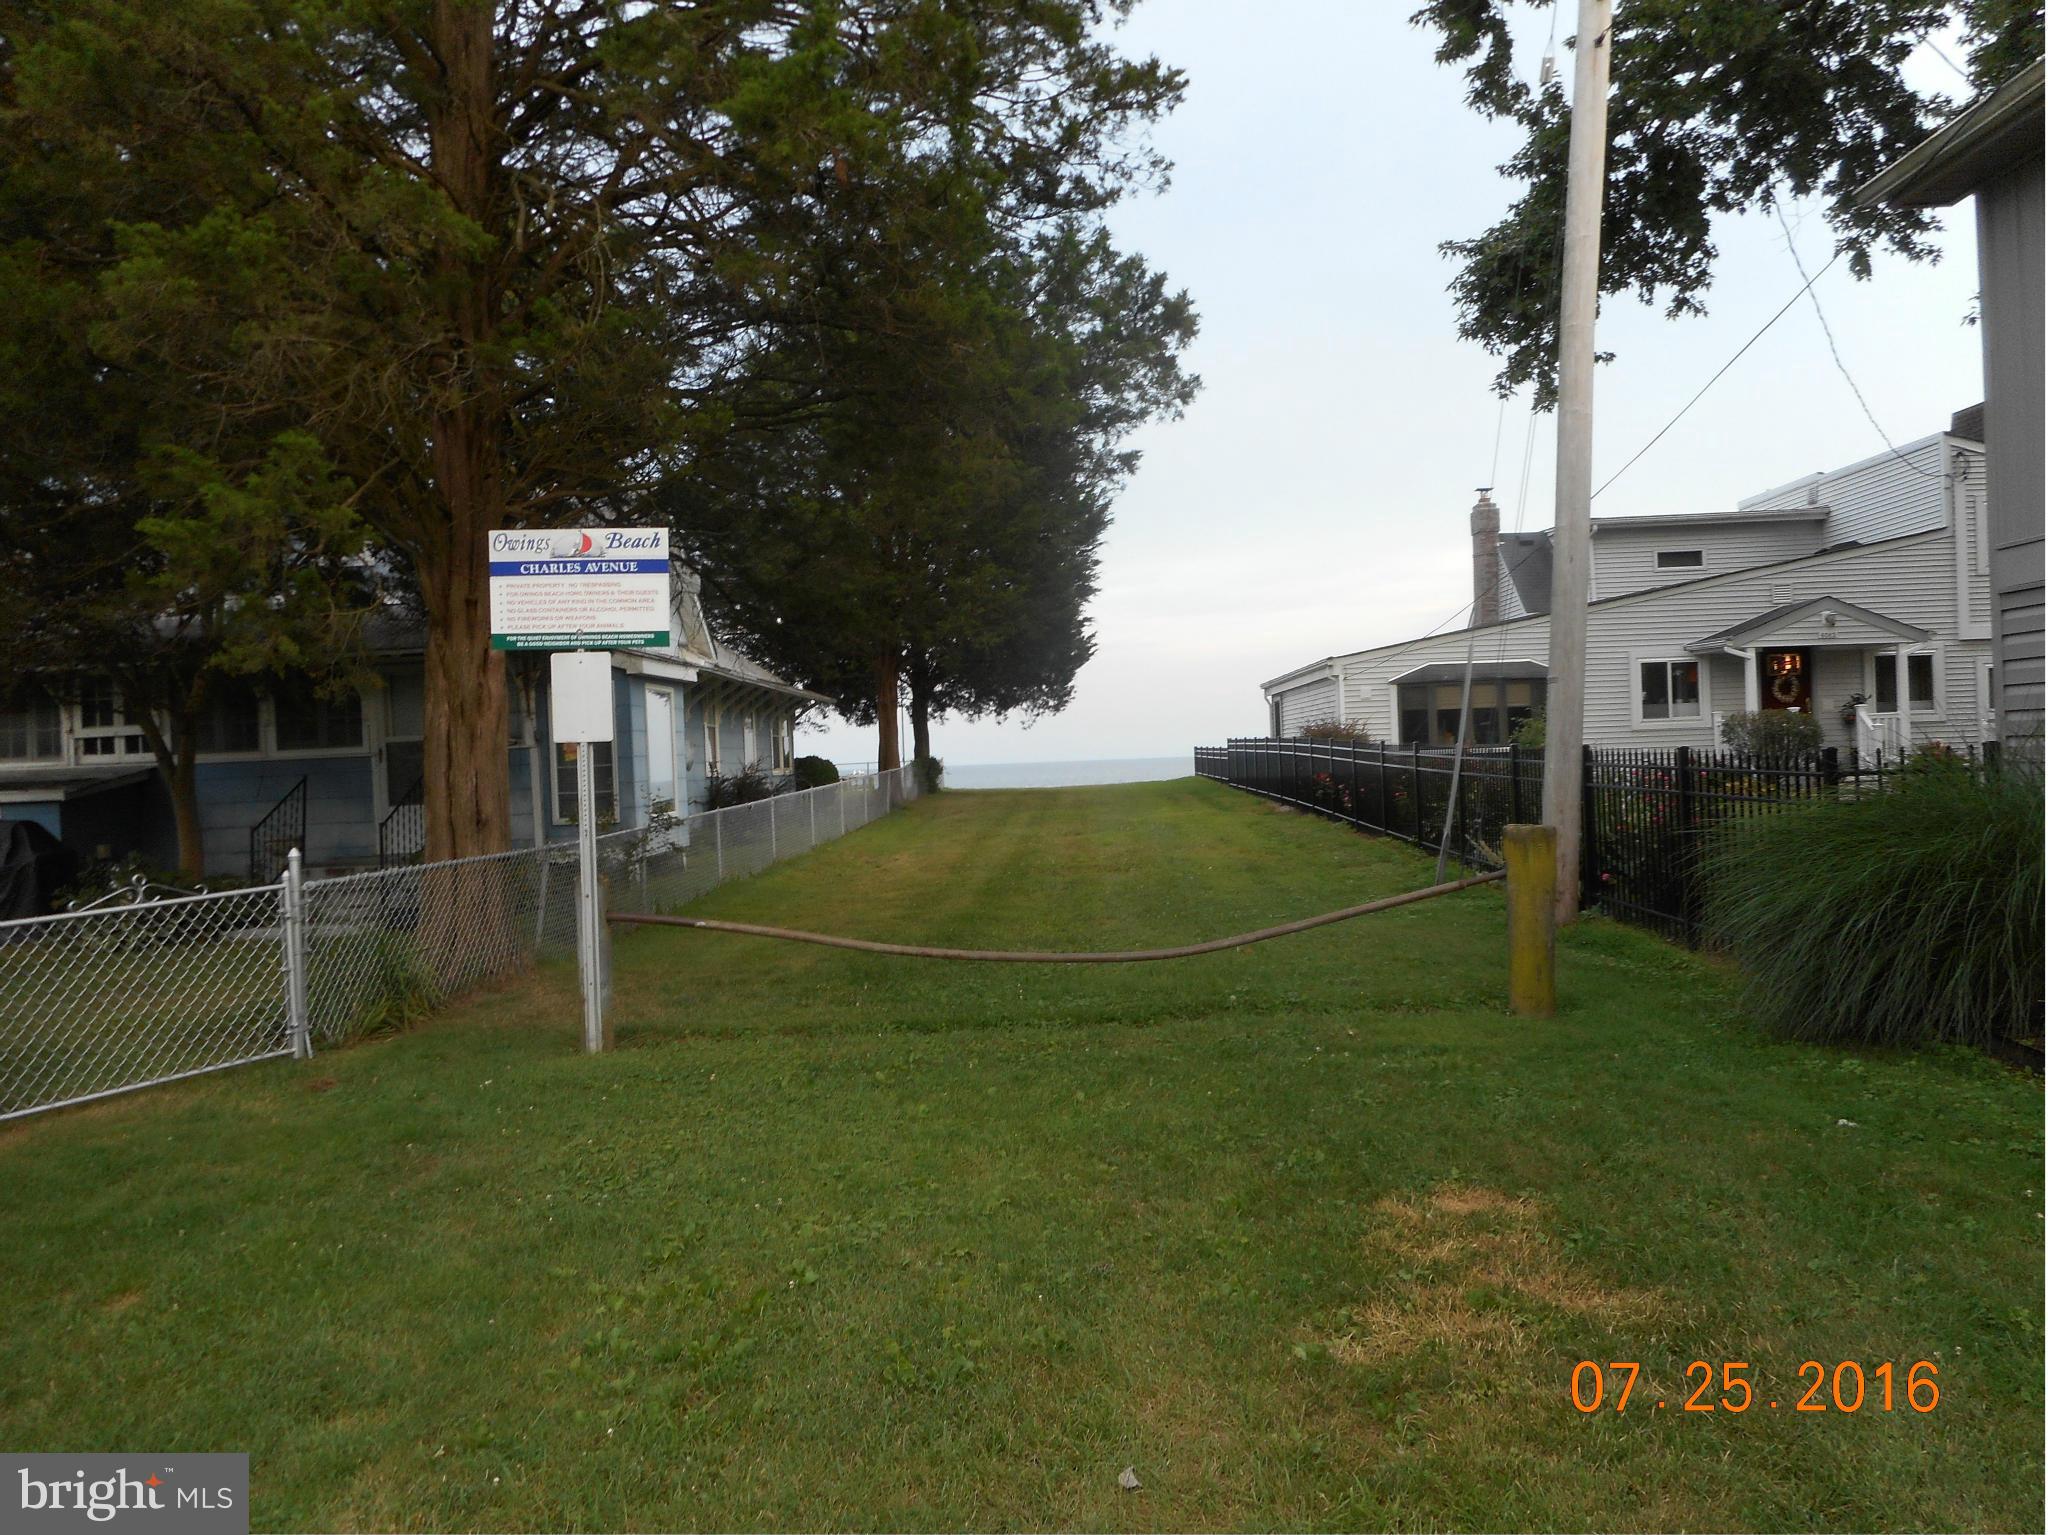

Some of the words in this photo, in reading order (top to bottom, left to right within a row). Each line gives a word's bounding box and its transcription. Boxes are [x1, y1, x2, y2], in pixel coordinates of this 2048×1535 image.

[493, 533, 549, 553] Owings
[605, 532, 661, 550] Beach
[520, 563, 581, 574] CHARLES
[585, 562, 638, 573] AVENUE
